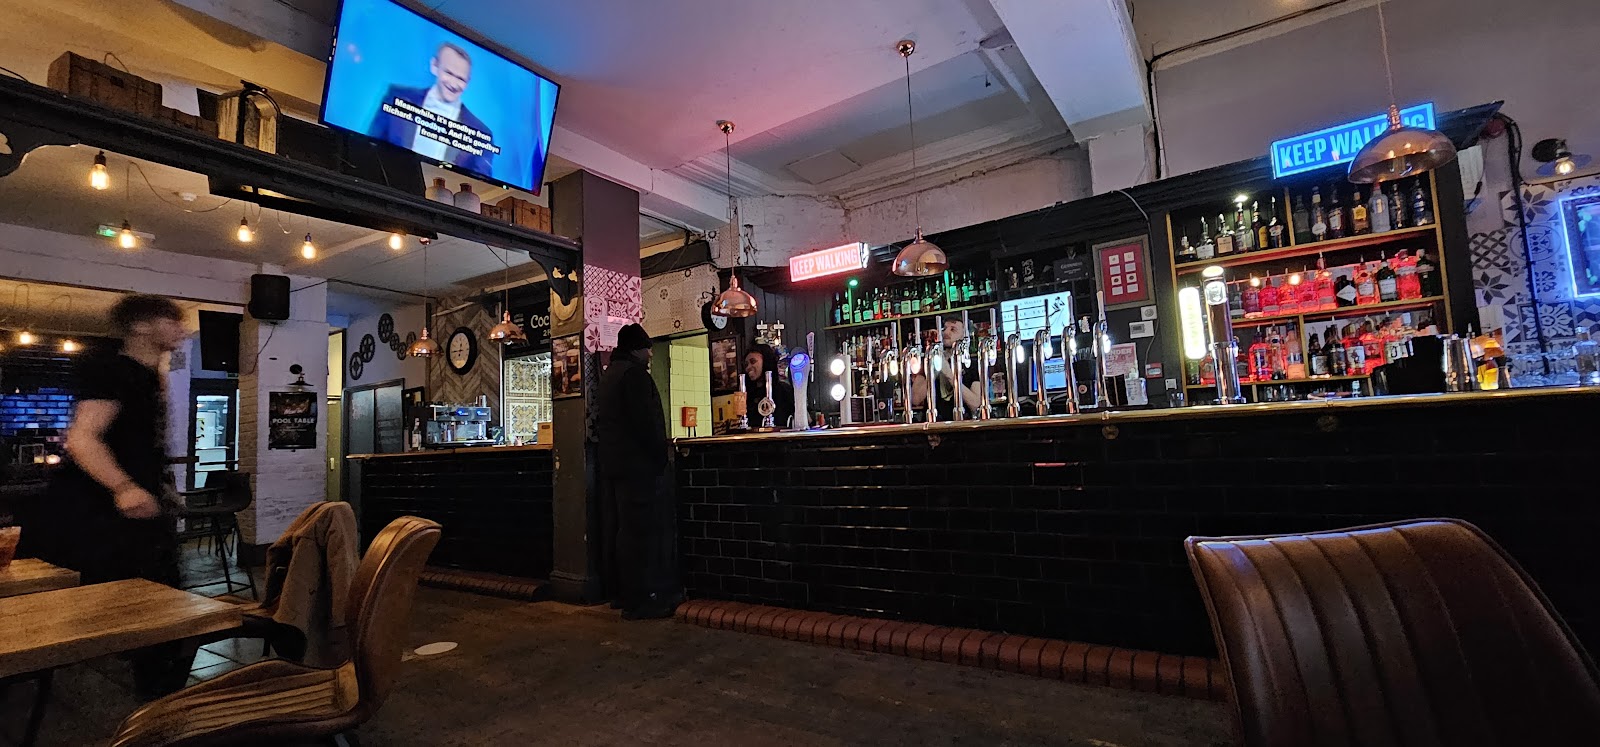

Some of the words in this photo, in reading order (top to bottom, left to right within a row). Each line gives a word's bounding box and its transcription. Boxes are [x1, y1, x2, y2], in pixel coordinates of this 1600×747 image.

[382, 103, 413, 122] Richard.
[414, 116, 448, 135] Goodbye.
[448, 129, 463, 140] And
[462, 134, 473, 144] it's
[473, 139, 500, 154] goodbye
[394, 98, 436, 121] Meanwhile,
[436, 115, 448, 126] it's
[447, 120, 476, 136] goodbye
[476, 129, 492, 142] from
[421, 128, 438, 141] from
[438, 134, 451, 146] me.
[452, 139, 483, 156] Goodbye!
[1279, 138, 1327, 169] KEEP
[1329, 113, 1425, 161] WALKG
[793, 259, 815, 276] KEEP
[815, 248, 858, 272] WALKING
[1109, 347, 1133, 357] NDER
